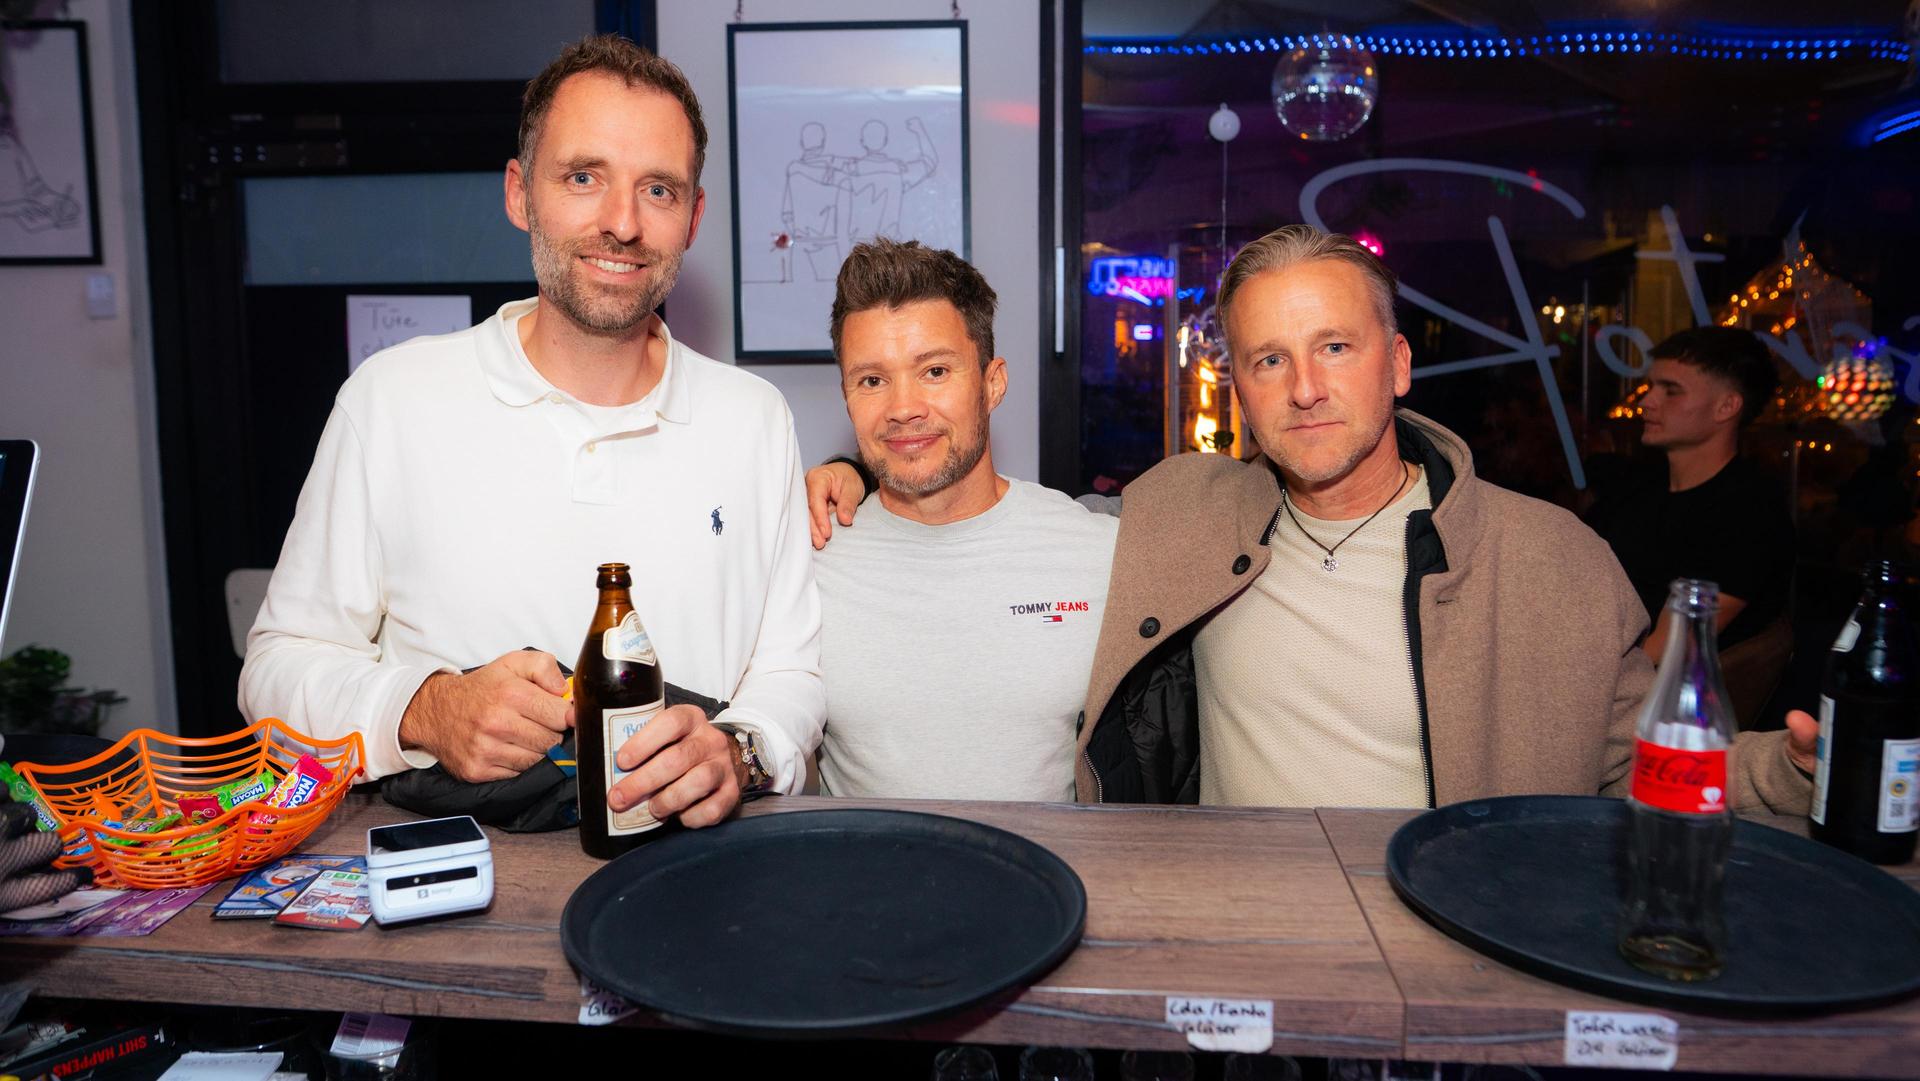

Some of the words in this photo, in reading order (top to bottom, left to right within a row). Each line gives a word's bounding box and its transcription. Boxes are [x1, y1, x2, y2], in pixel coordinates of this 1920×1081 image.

[1009, 602, 1052, 615] TOMMY
[1055, 601, 1089, 612] JEANS
[232, 784, 263, 806] MAOAM
[118, 1035, 149, 1057] SHIT
[52, 1050, 116, 1078] HAPPENS
